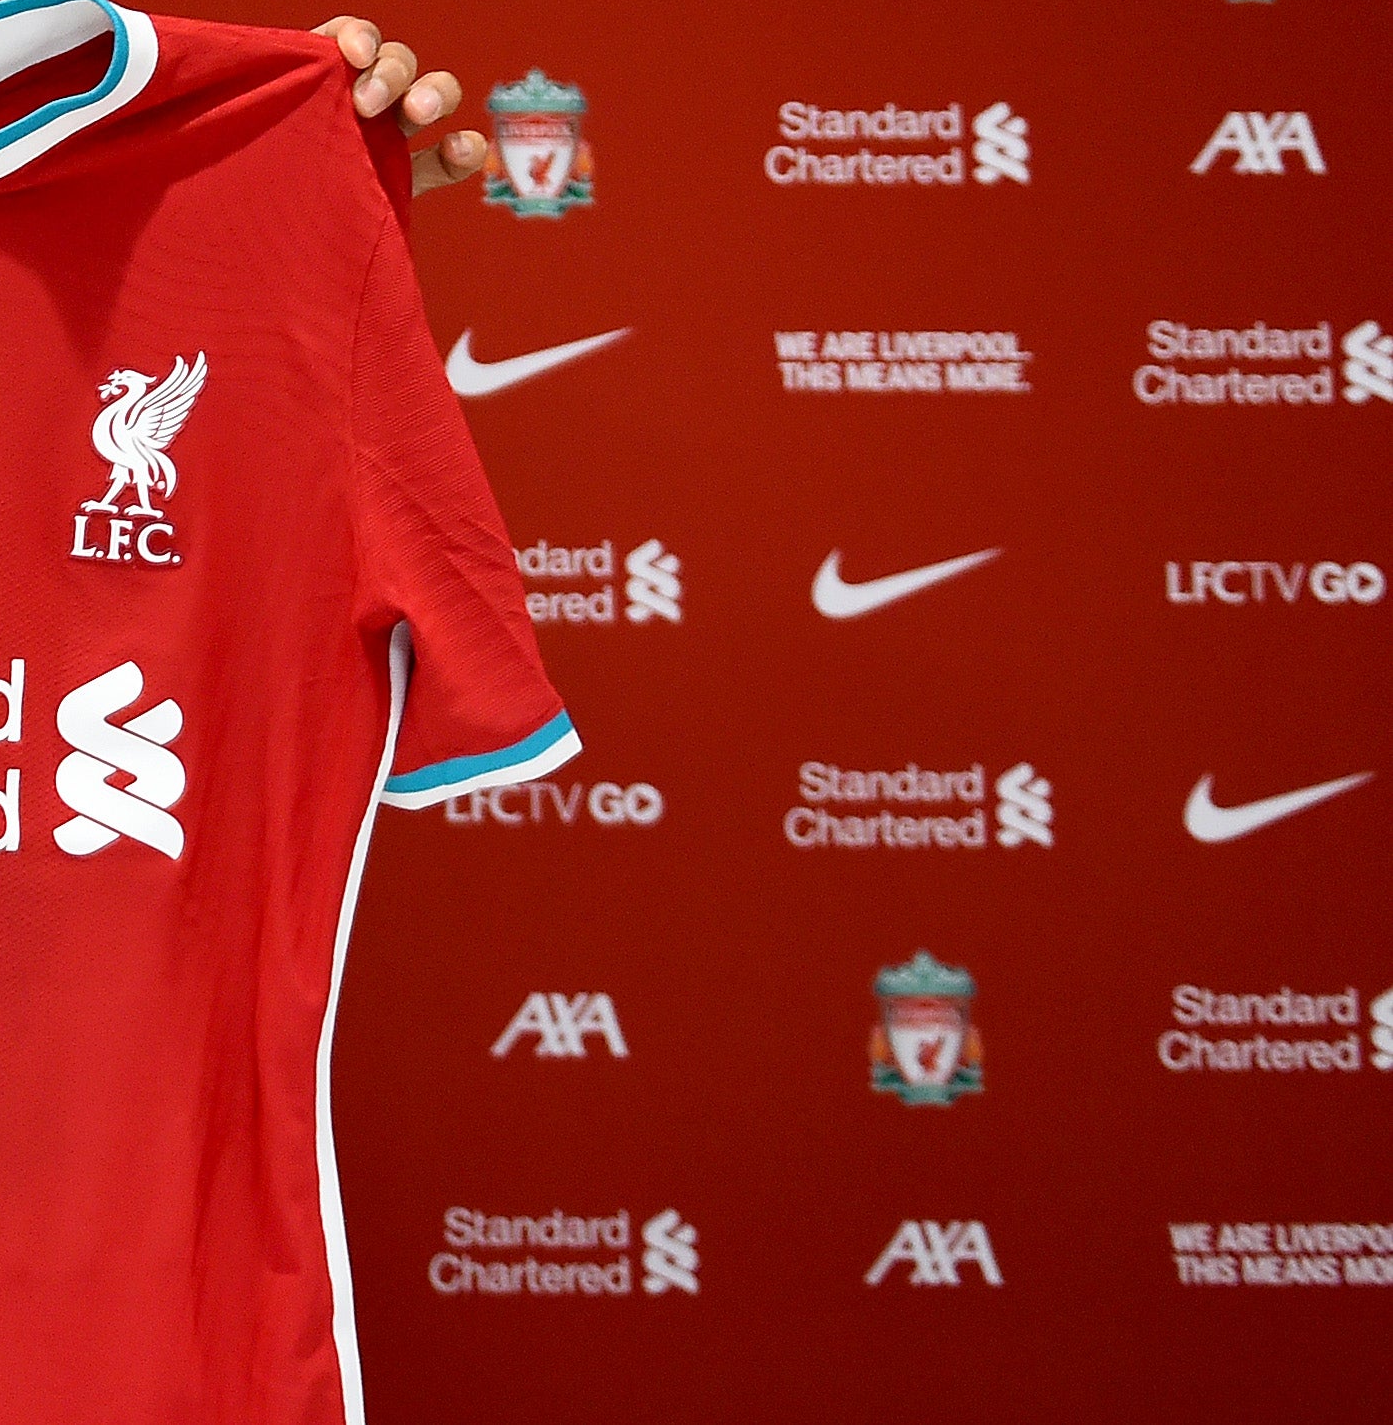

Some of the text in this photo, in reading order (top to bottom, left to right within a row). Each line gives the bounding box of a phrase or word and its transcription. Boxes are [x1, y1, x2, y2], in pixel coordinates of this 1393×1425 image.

[780, 102, 964, 140] Standard
[764, 146, 965, 185] Chartered
[70, 514, 182, 565] L.F.C.
[1173, 985, 1359, 1025] Standard
[1159, 1030, 1361, 1070] Chartered
[445, 1207, 630, 1248] Standard
[429, 1253, 631, 1294] Chartered
